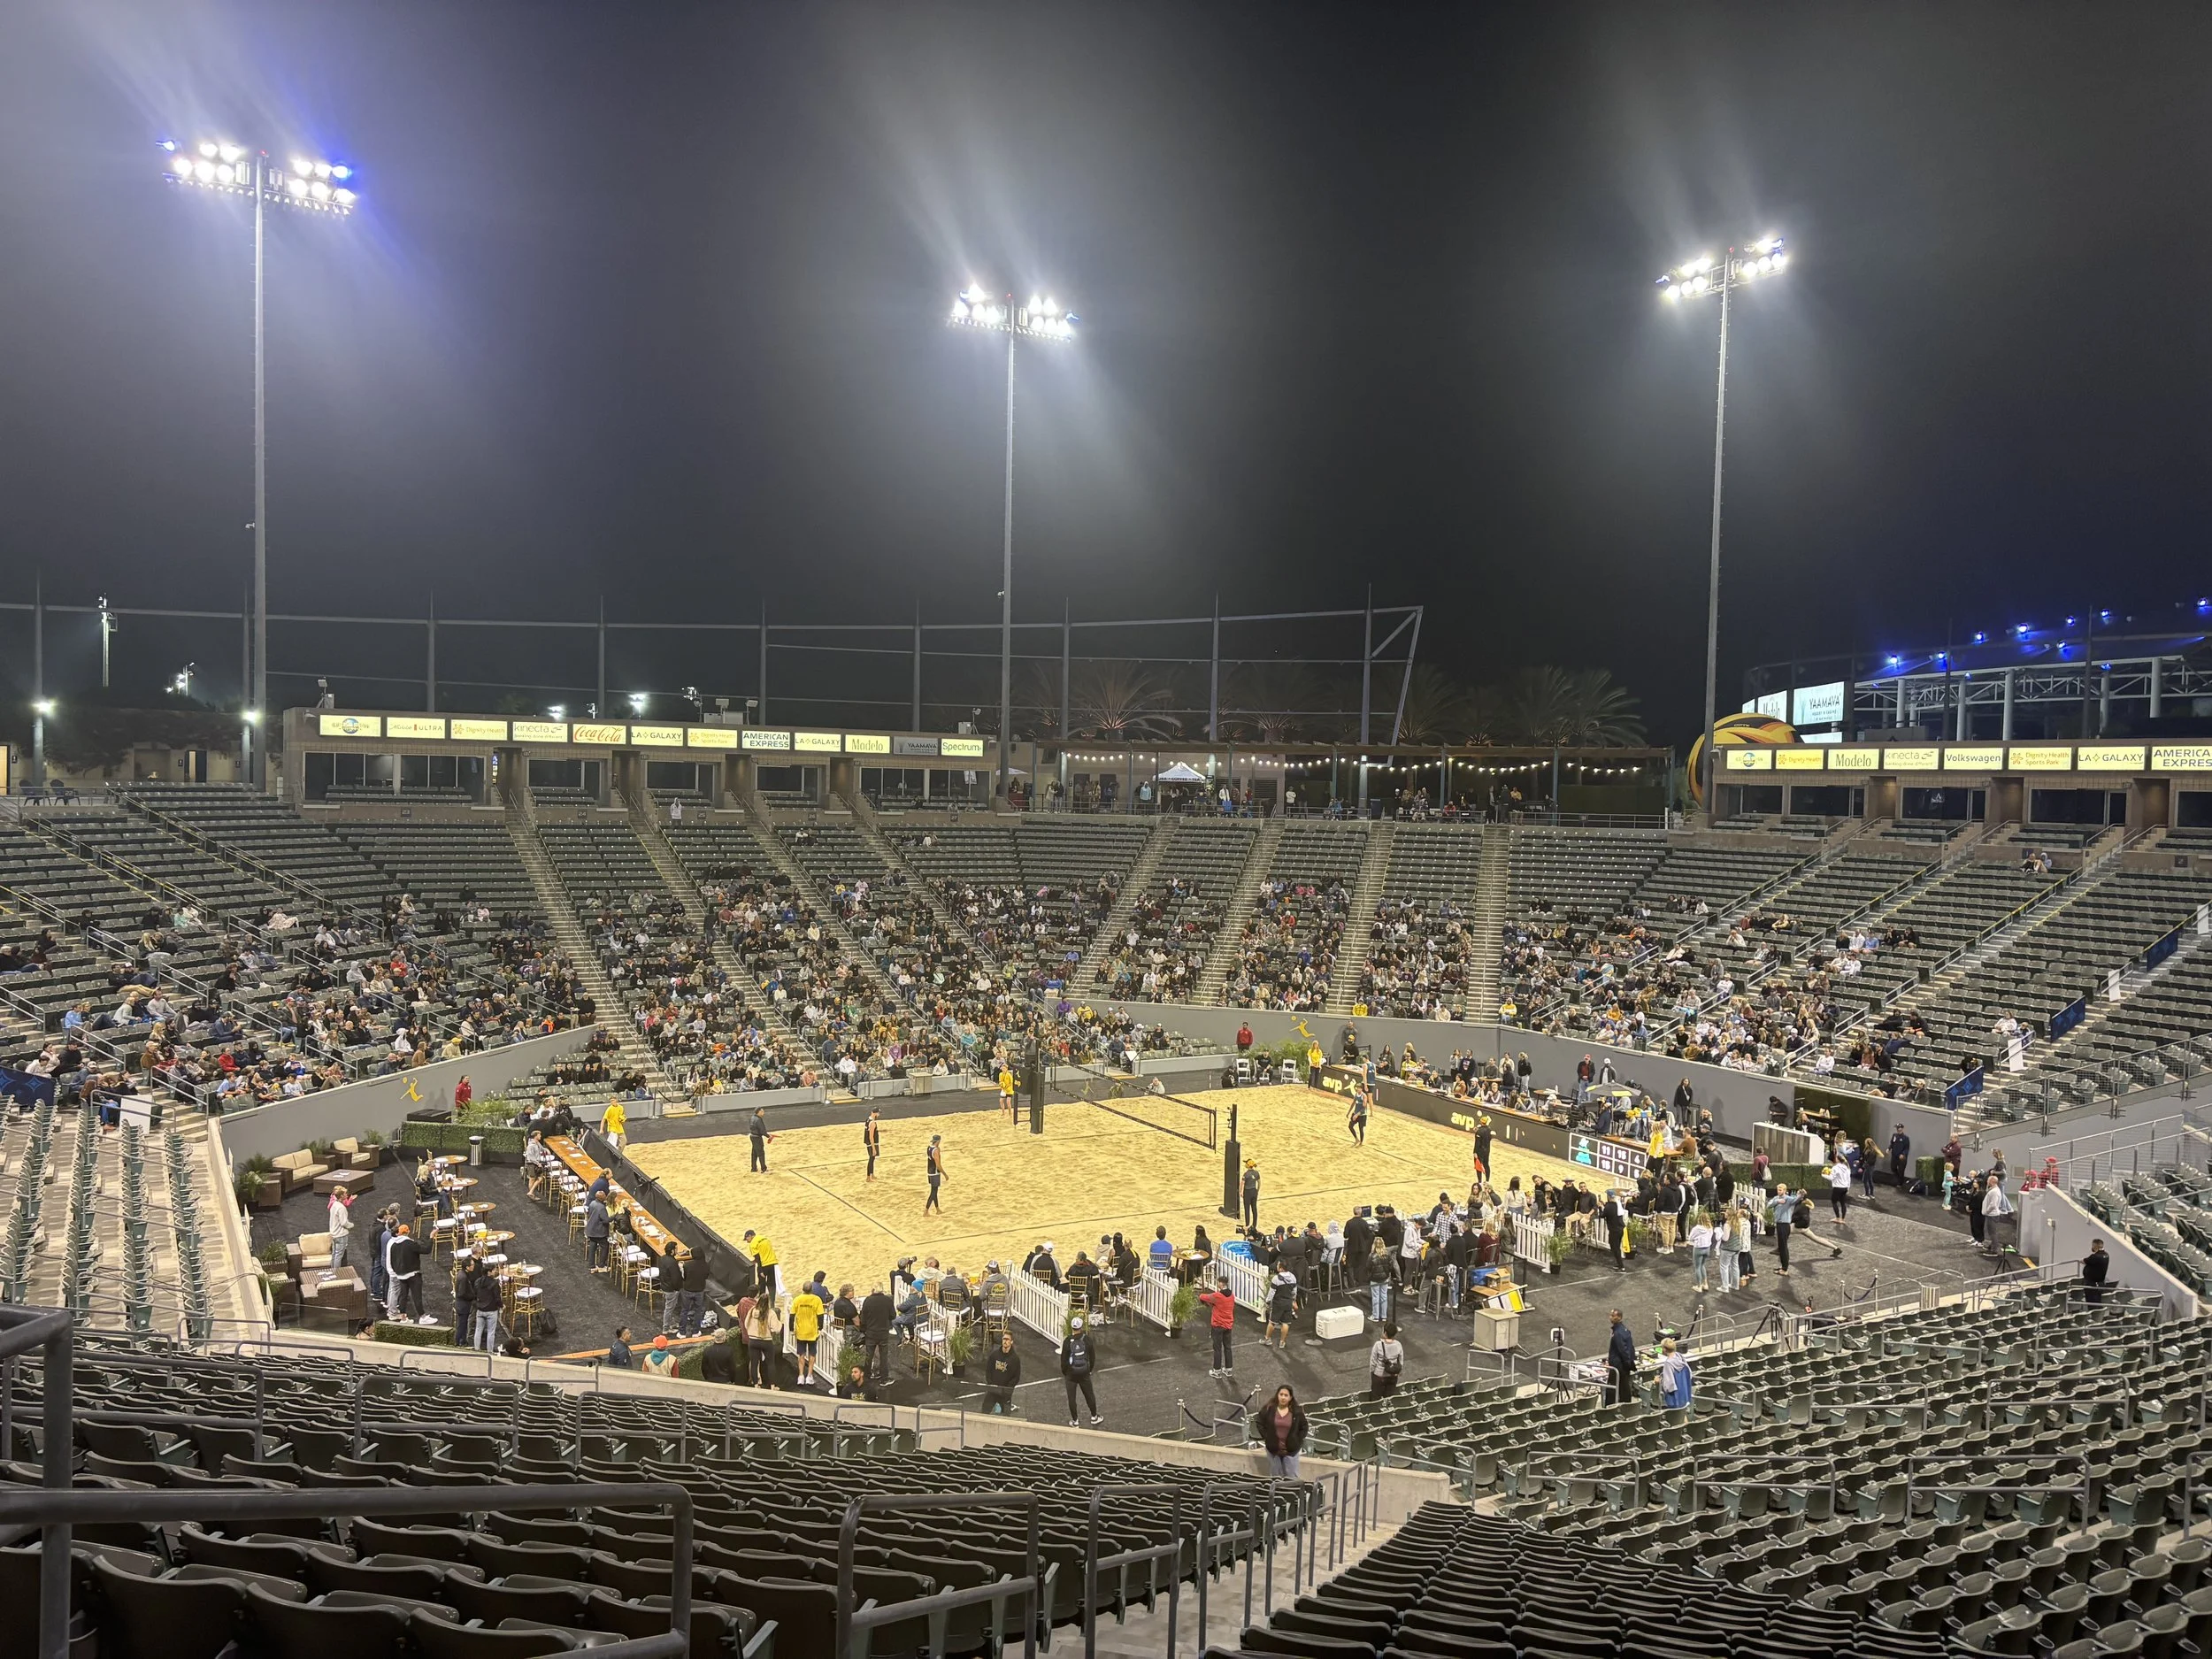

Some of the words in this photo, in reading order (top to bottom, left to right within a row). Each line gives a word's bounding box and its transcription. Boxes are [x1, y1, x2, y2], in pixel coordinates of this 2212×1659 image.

[851, 739, 883, 751] Modelo
[942, 742, 979, 752] Spectrum
[1835, 754, 1871, 767] Modelo
[1947, 754, 2001, 763] Volkswagen
[1323, 1076, 1343, 1094] avp
[1451, 1111, 1474, 1131] avp
[1601, 1145, 1610, 1156] 11
